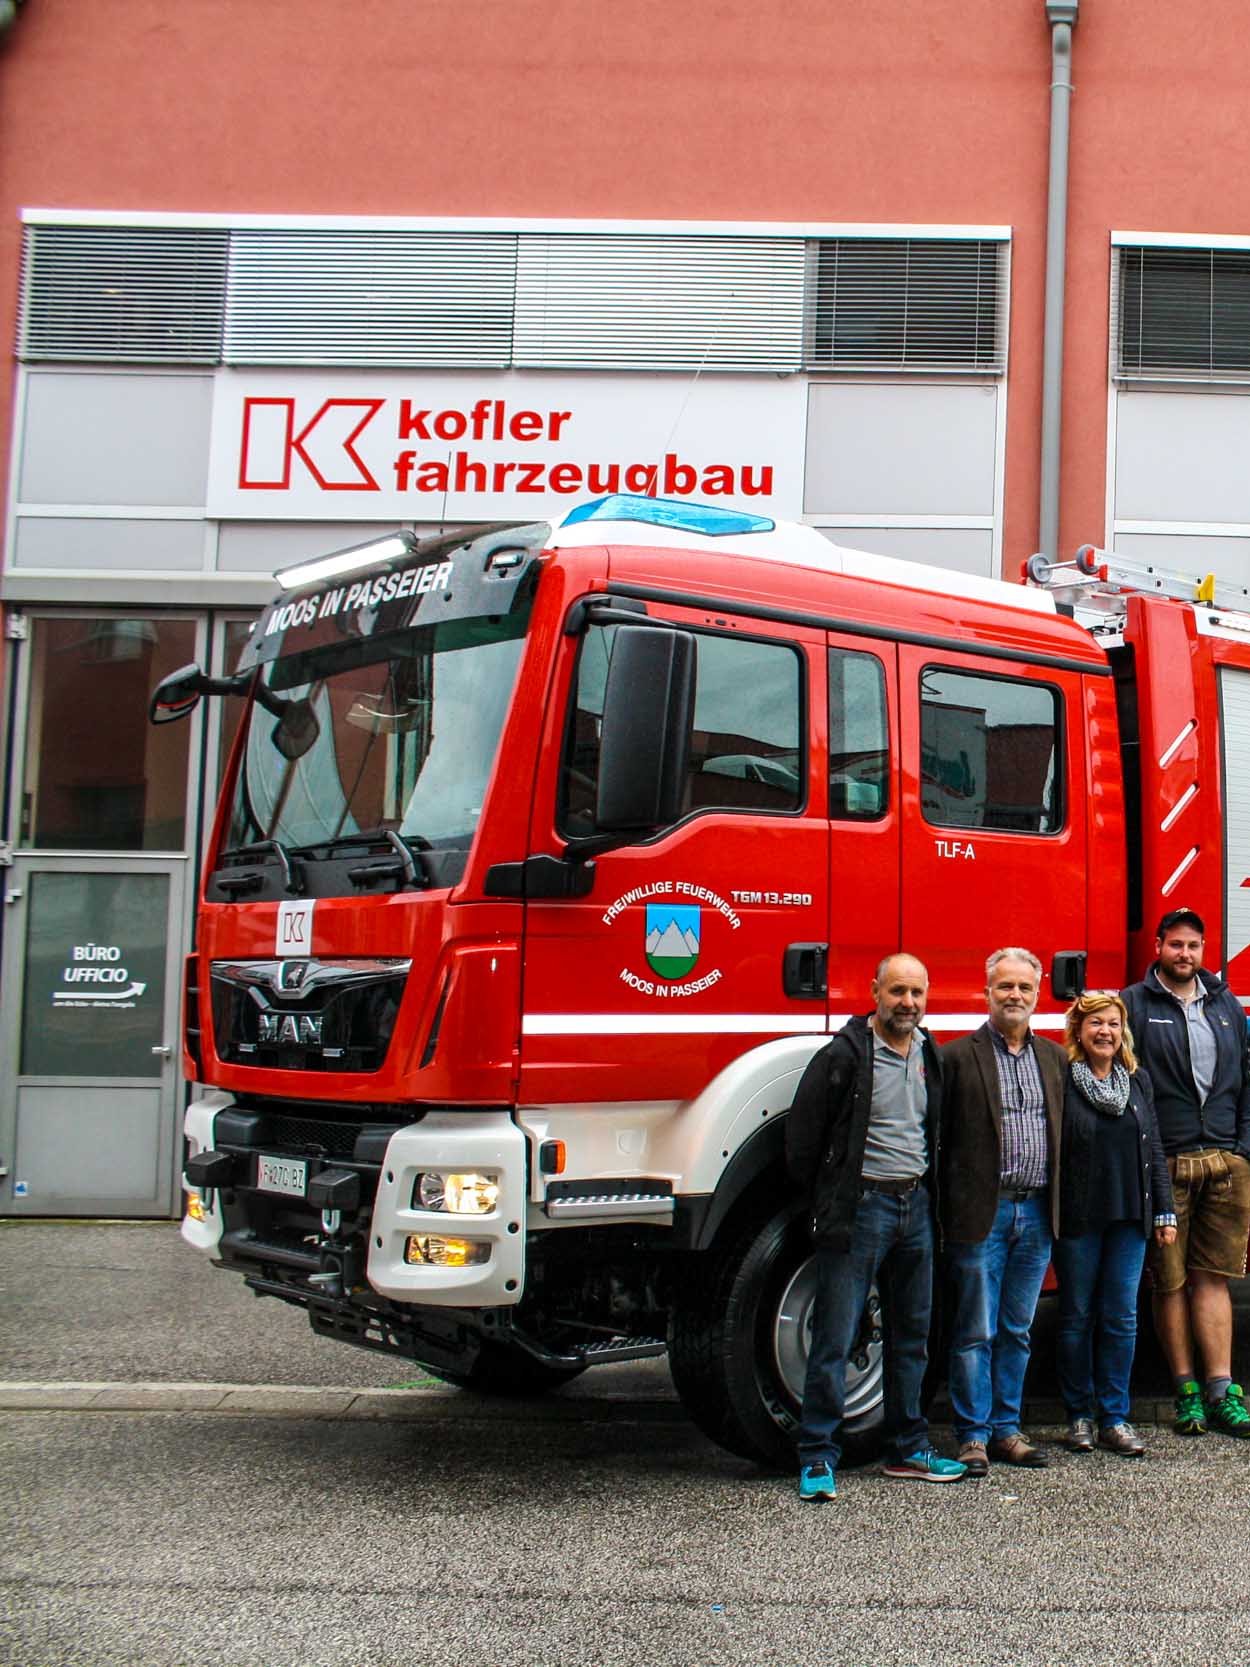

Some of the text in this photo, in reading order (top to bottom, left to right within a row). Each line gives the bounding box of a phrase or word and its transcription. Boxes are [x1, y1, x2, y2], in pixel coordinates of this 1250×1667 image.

[398, 400, 572, 441] kofler
[239, 397, 386, 491] K
[394, 451, 773, 498] fahrzeugbau
[265, 562, 453, 636] MOOS IN PASSEIER
[935, 840, 976, 860] TLF-A
[602, 881, 742, 930] FREIWILLIGE FEUERWEHR
[731, 890, 812, 906] TGM 13.290
[73, 942, 120, 961] BÜRO
[64, 968, 128, 982] UFFICIO
[619, 968, 723, 998] MOOS IN PASSEIER
[258, 1014, 323, 1044] MAN
